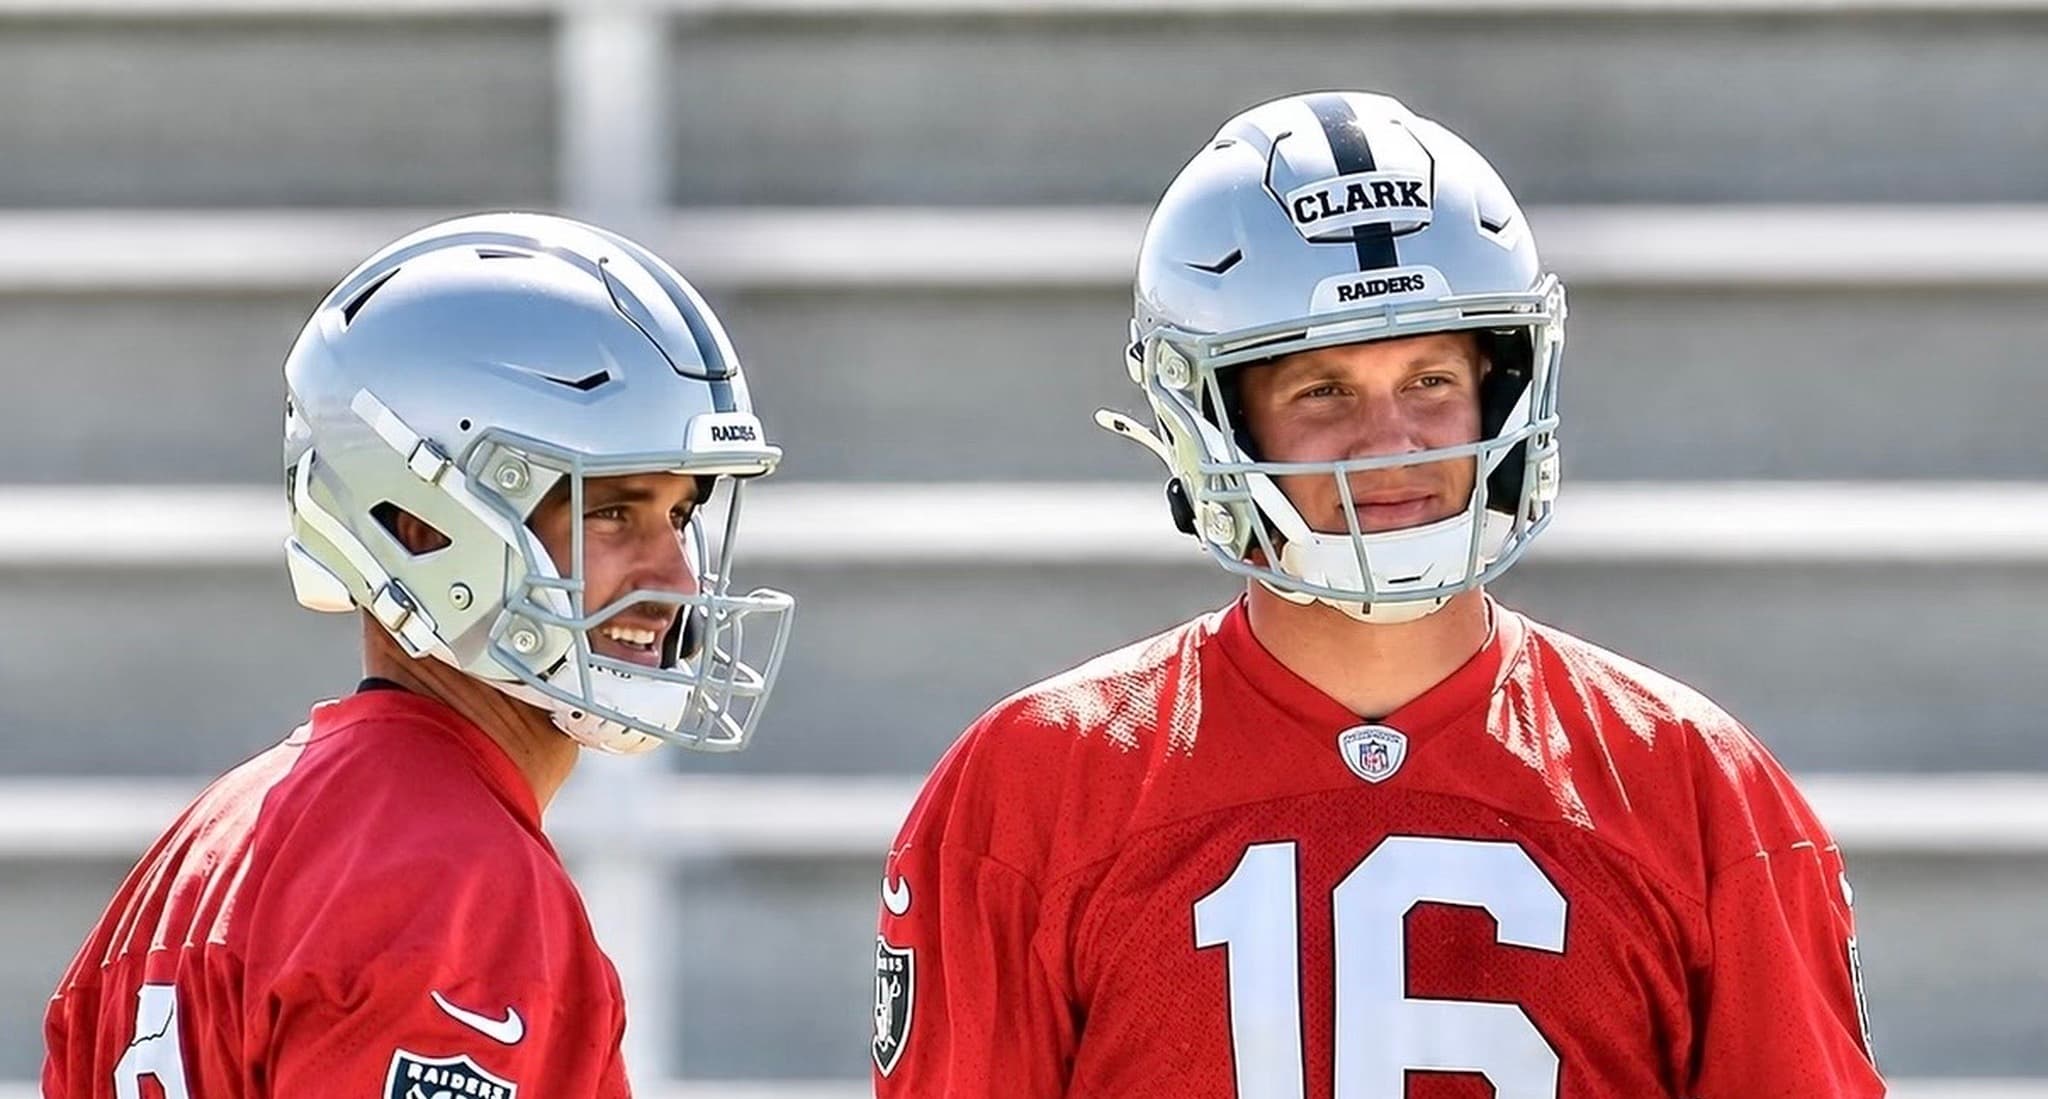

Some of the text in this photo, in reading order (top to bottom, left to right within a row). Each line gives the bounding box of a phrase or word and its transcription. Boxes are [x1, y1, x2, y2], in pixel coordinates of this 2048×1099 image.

[1293, 180, 1429, 224] CLARK
[1336, 273, 1426, 302] RAIDERS
[1193, 835, 1568, 1099] 16
[407, 1062, 504, 1099] RAIDERS
